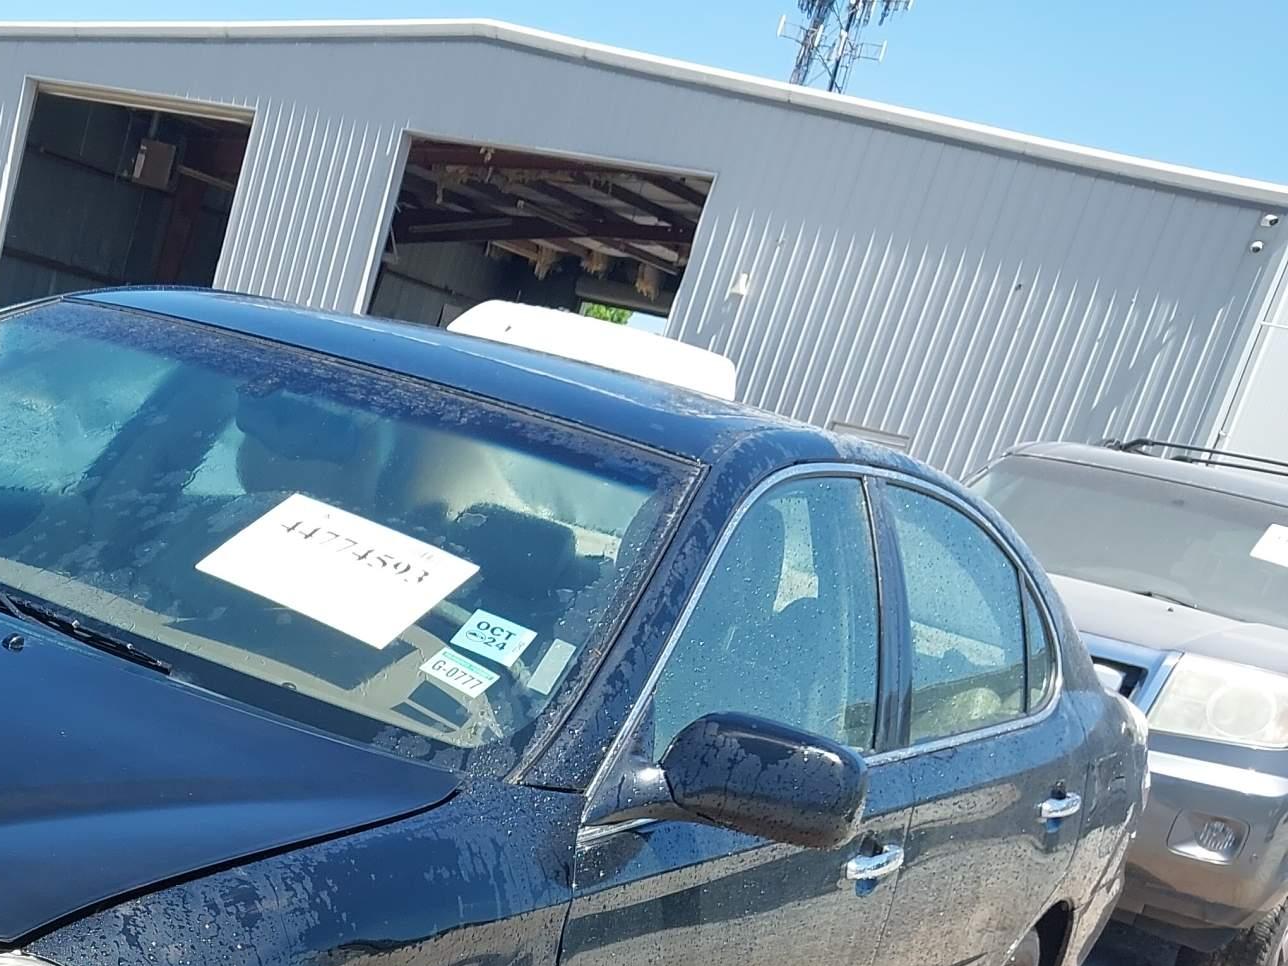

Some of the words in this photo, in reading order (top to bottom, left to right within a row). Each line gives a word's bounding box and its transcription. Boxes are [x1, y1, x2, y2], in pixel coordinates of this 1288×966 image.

[280, 520, 430, 584] 44774593
[476, 620, 516, 641] OCT
[483, 636, 508, 652] 24
[431, 659, 483, 690] G-0777
